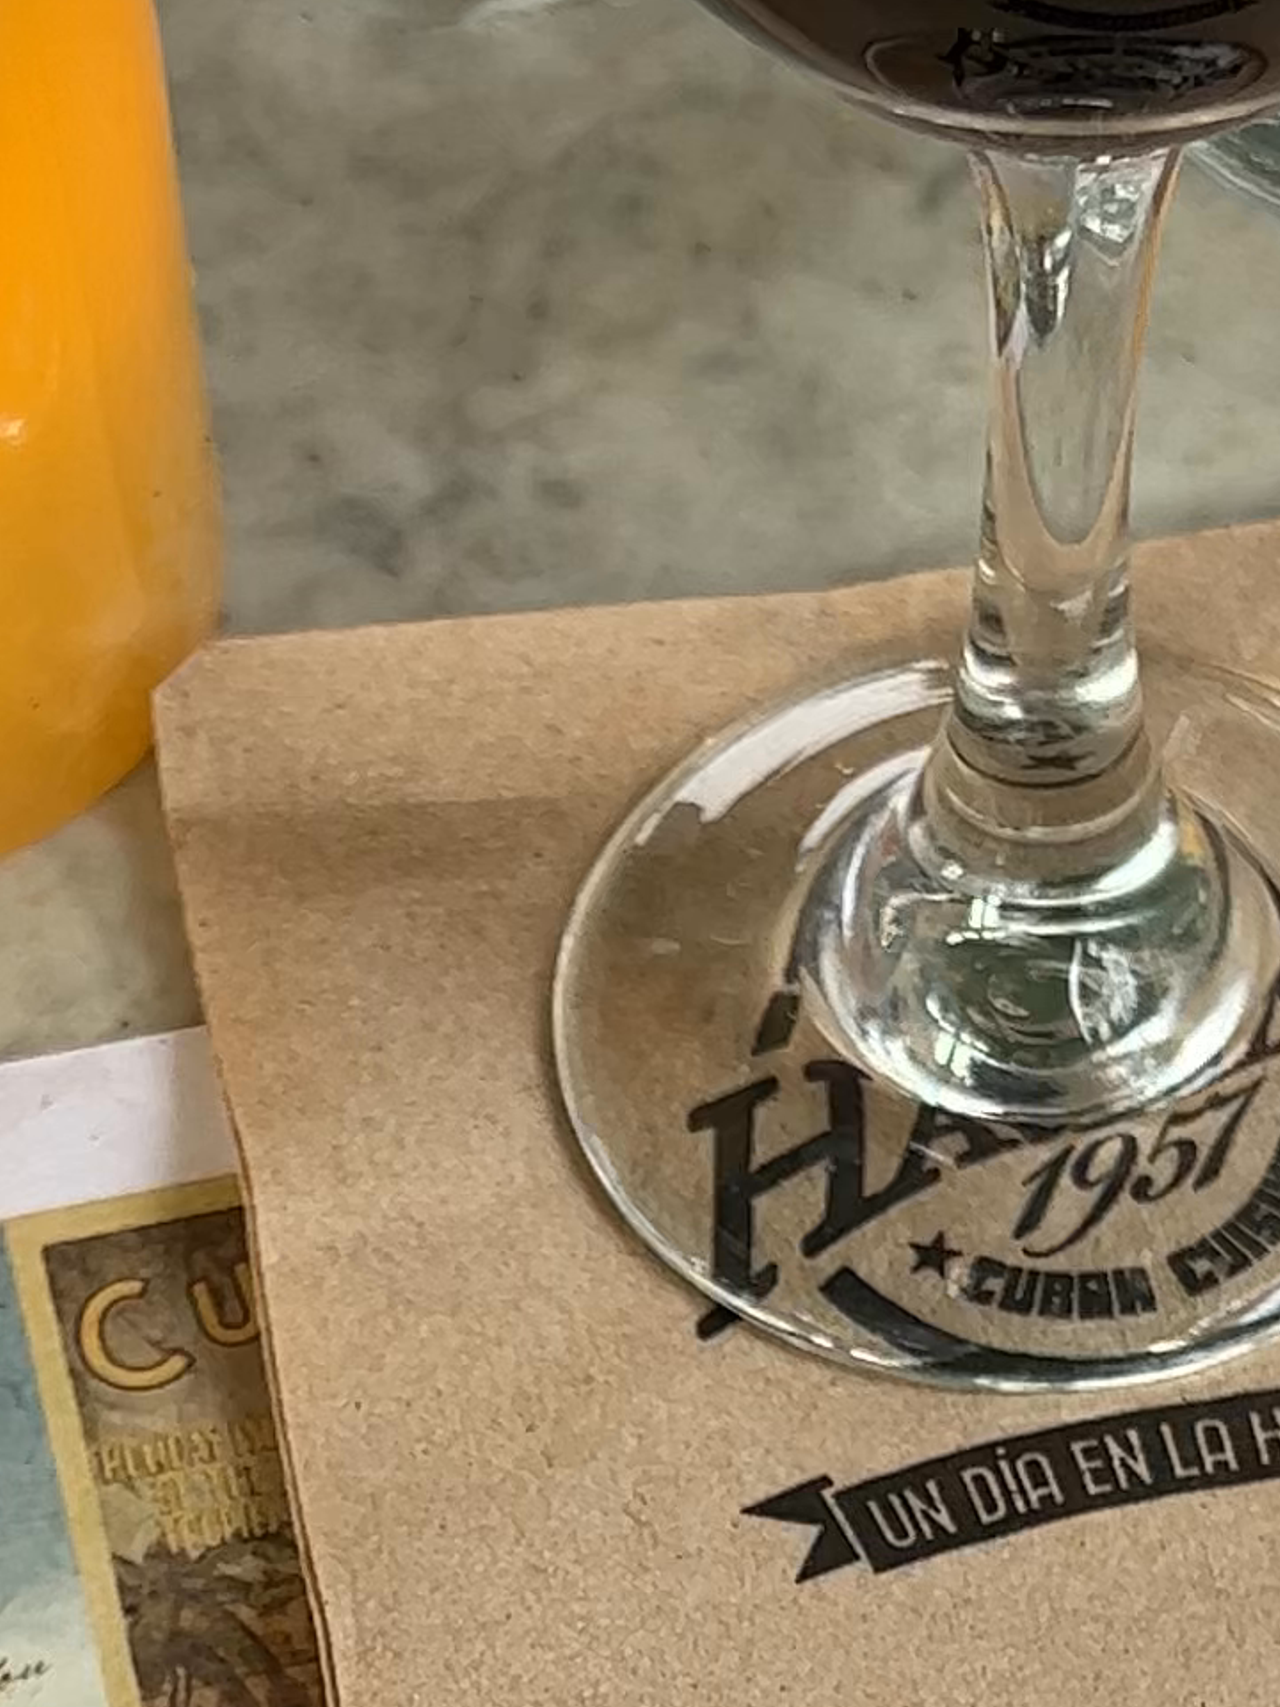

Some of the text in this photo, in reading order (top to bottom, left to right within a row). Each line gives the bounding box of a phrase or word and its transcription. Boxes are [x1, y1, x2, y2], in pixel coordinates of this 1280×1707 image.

[1013, 1076, 1267, 1259] 1957
[960, 1253, 1158, 1322] CUBAN
[866, 1478, 958, 1549] UN
[1069, 1428, 1154, 1496] EN
[1159, 1418, 1240, 1481] LA
